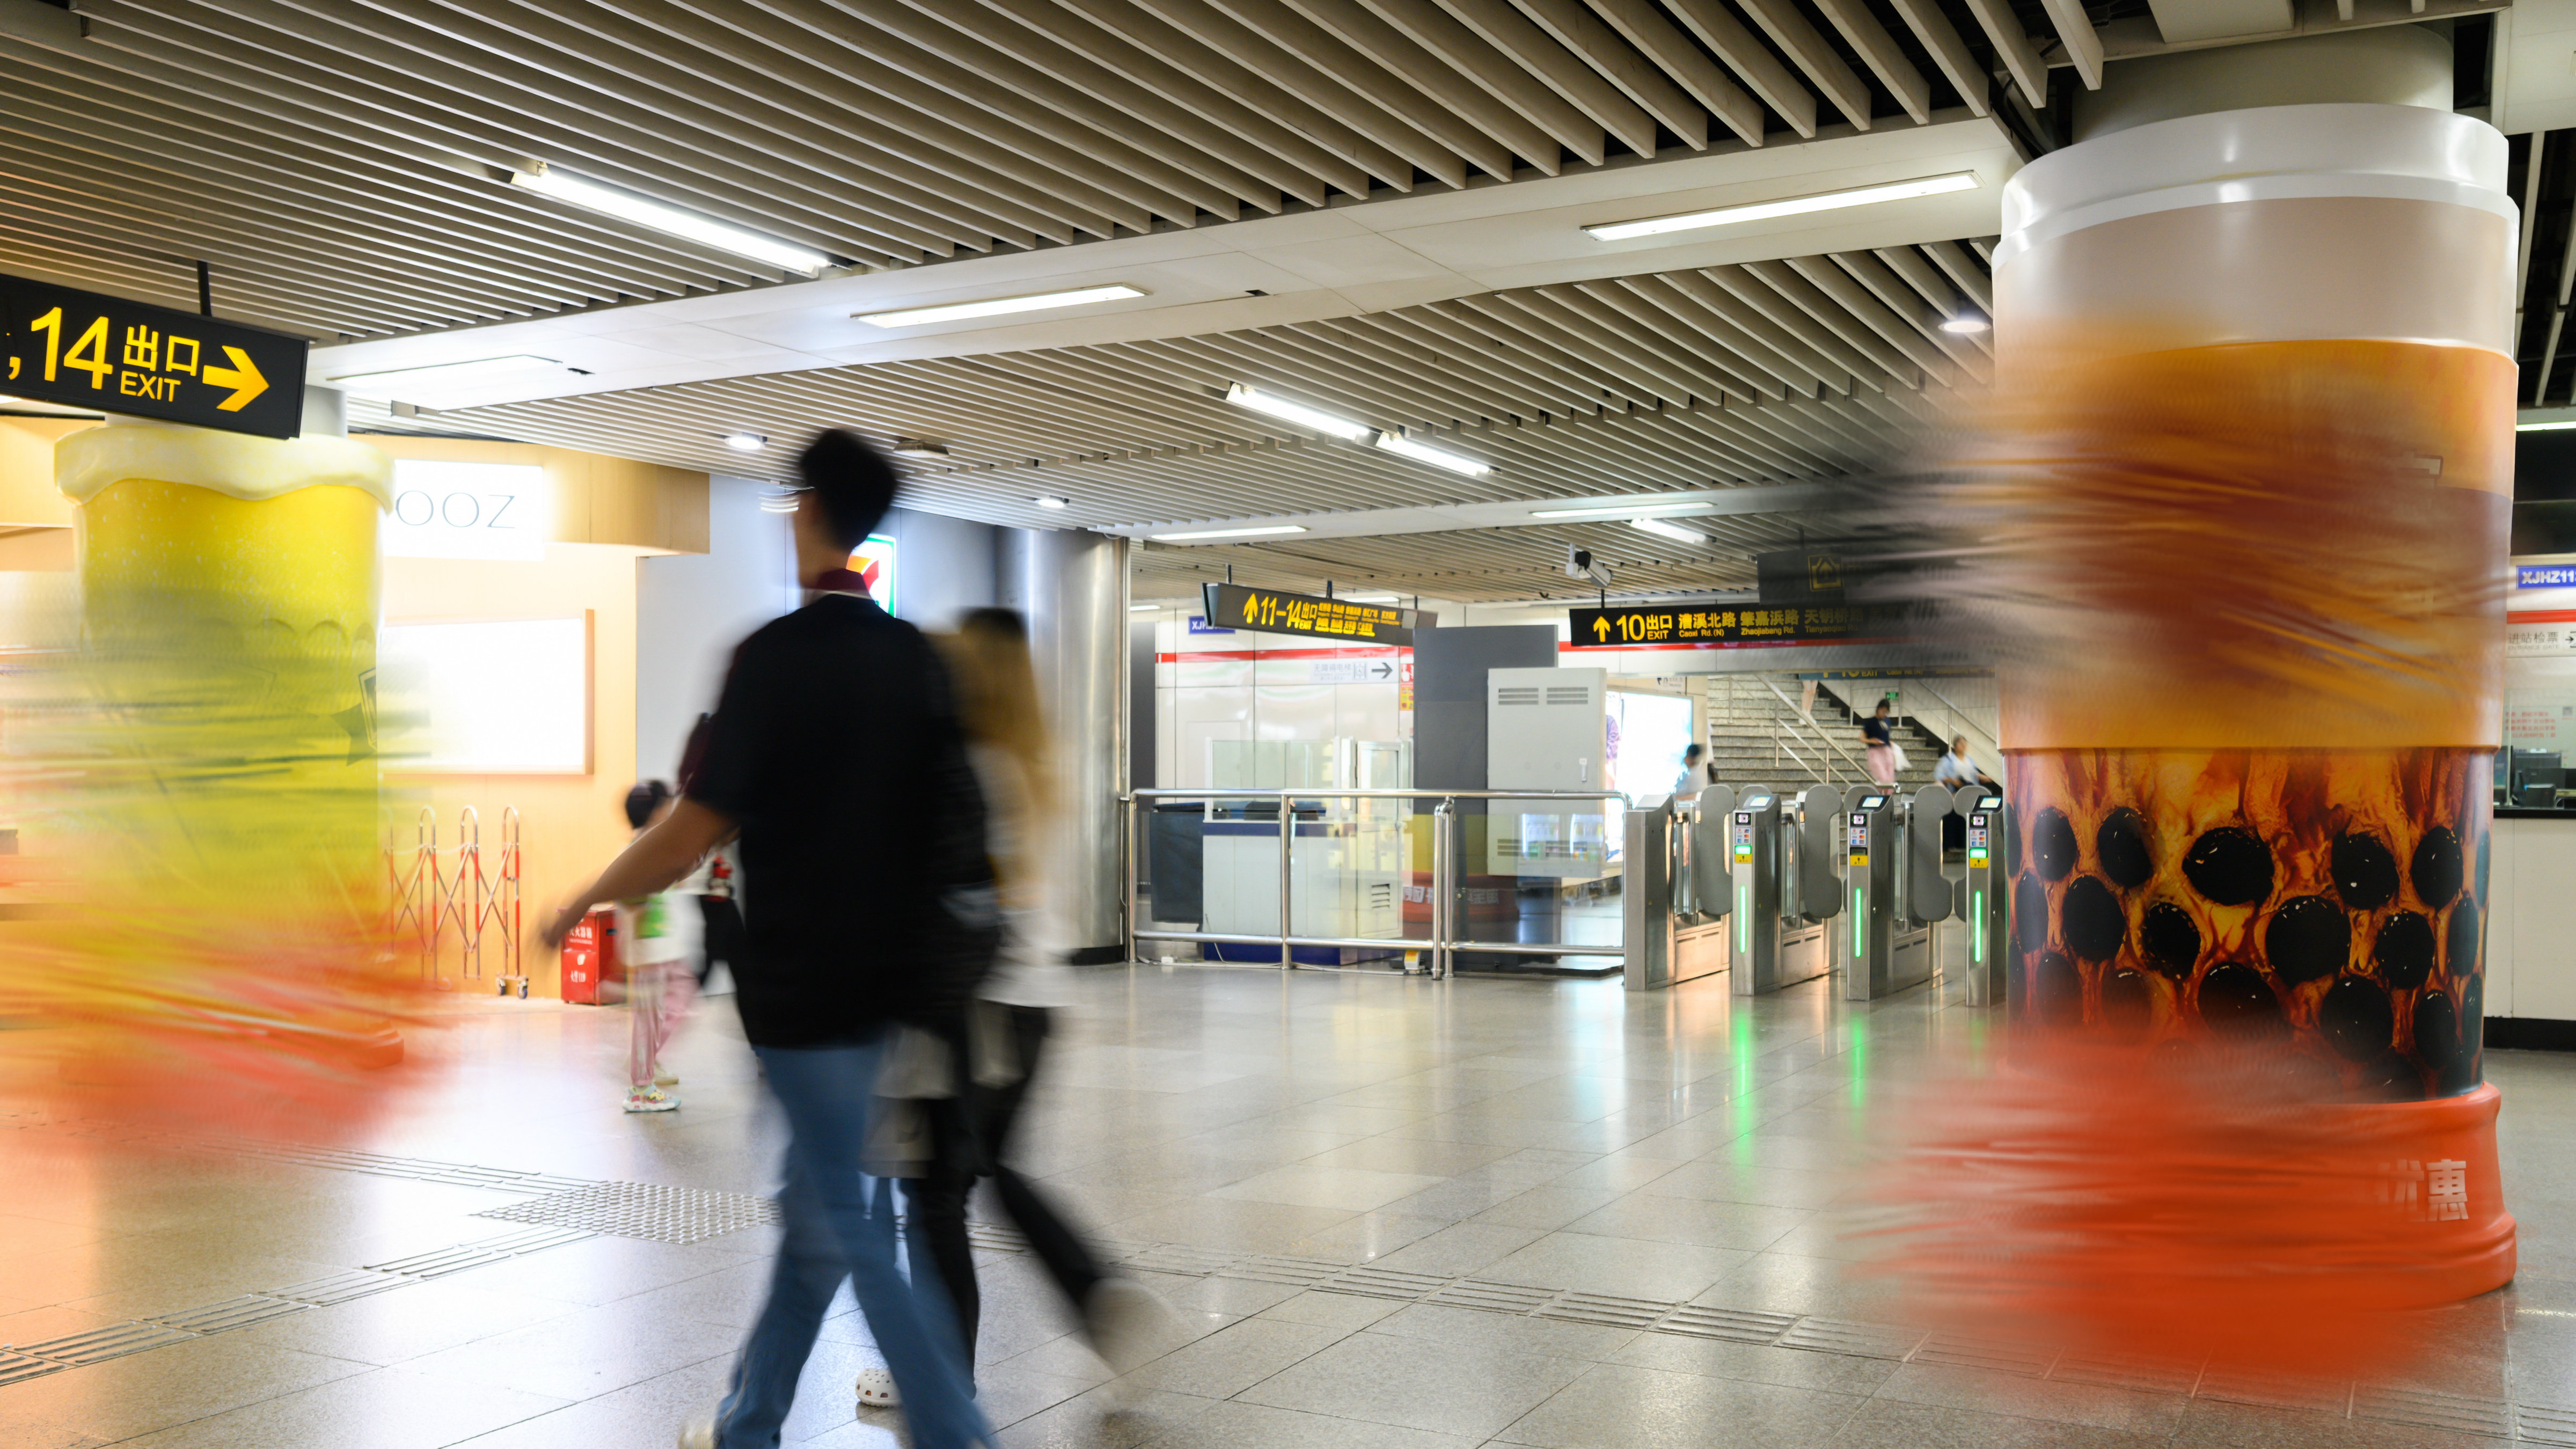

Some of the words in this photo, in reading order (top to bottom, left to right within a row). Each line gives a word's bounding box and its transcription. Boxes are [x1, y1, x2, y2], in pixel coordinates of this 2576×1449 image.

[123, 324, 201, 377] 出口
[120, 370, 181, 402] EXIT
[2521, 570, 2576, 584] XJHZ11
[1261, 596, 1302, 629] 11-14
[1301, 602, 1318, 619] 出口
[1299, 619, 1313, 631] EXIT
[1616, 614, 1646, 641] 10
[1646, 614, 1673, 630] 出口
[1678, 611, 1737, 630] 漕溪北路
[1740, 609, 1799, 627] 肇嘉浜路
[1804, 607, 1864, 624] 天钥桥路
[1647, 630, 1669, 640] EXIT
[1740, 627, 1782, 636] Zhaojiabang
[1783, 626, 1796, 634] Rd.
[1804, 625, 1846, 634] Tianyaoqiao
[2508, 631, 2559, 645] 进站检票
[1313, 663, 1351, 672] 无障碍电梯
